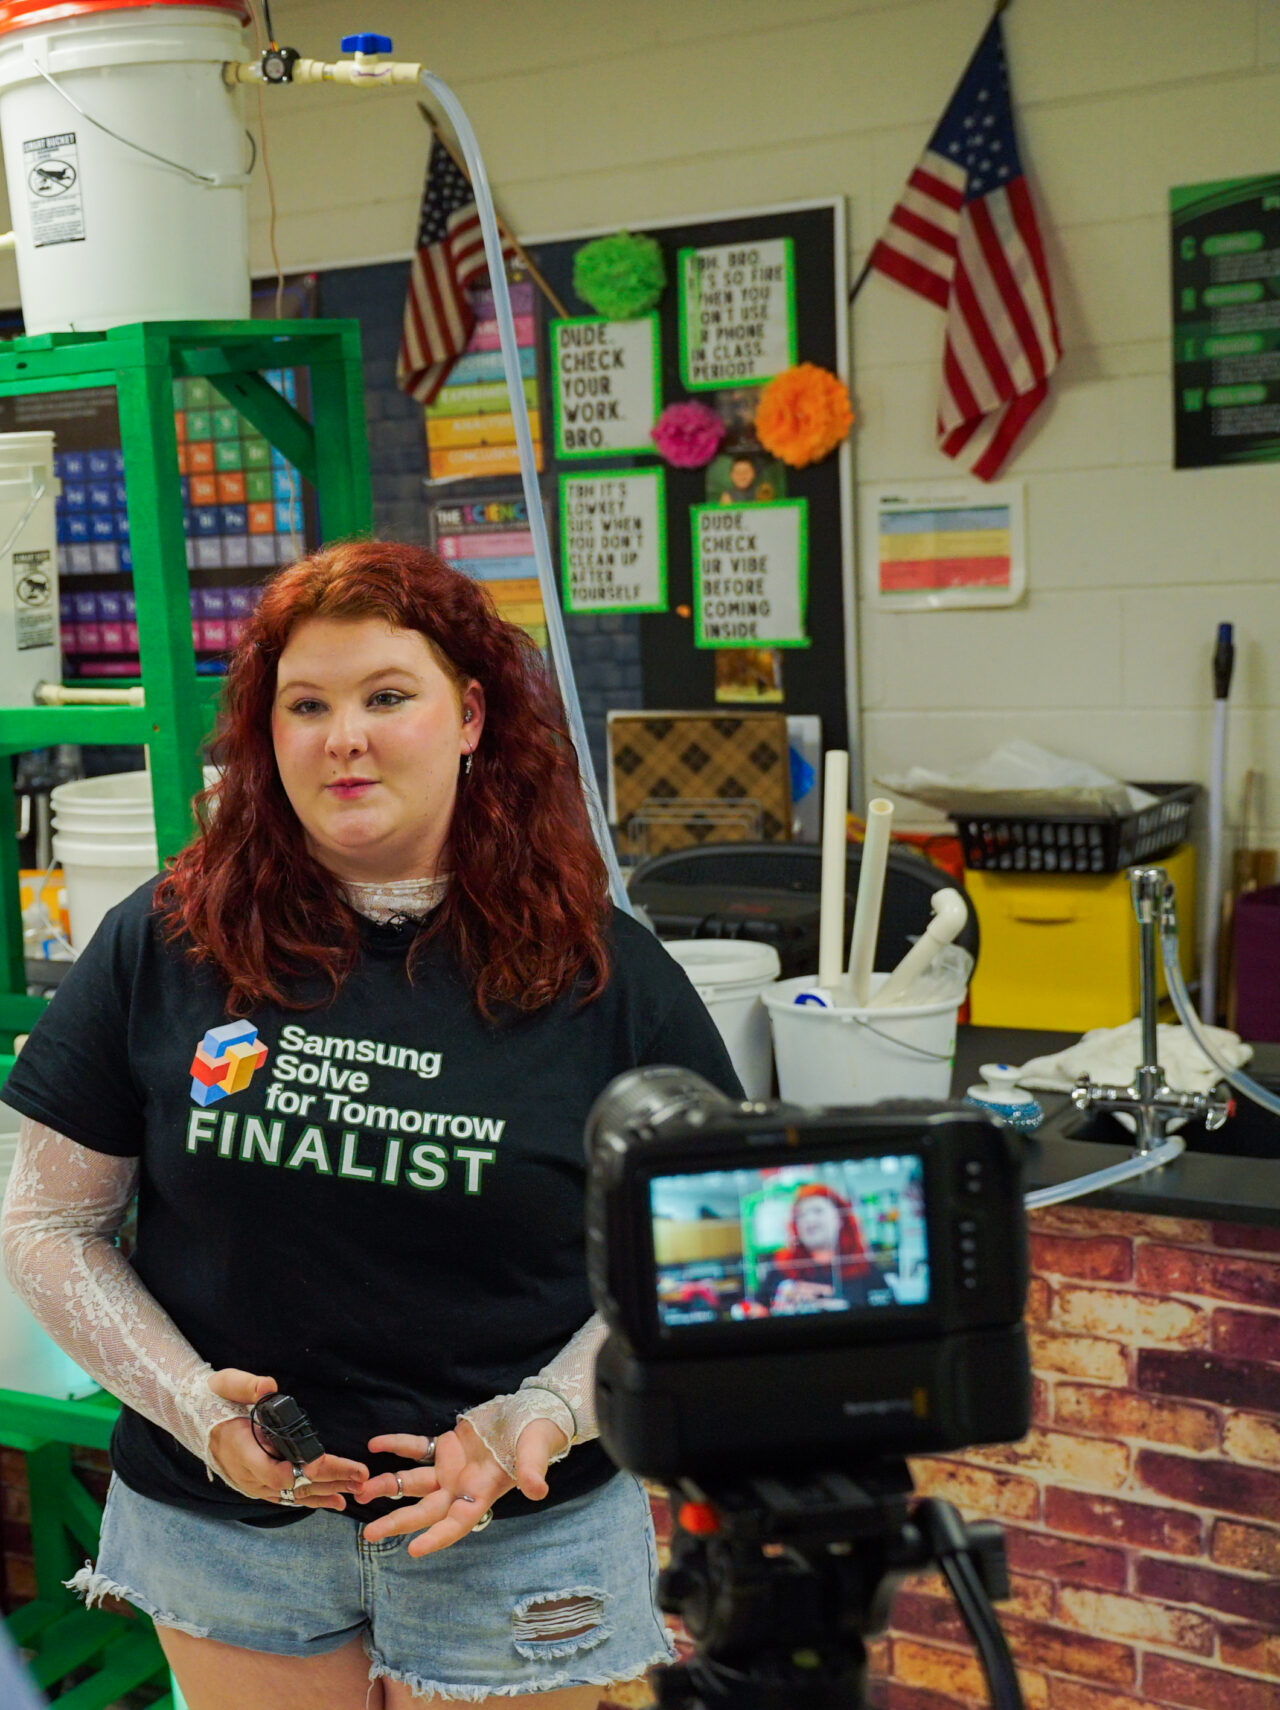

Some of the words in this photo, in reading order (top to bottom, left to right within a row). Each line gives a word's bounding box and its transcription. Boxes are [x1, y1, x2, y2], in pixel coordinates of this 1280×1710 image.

[723, 271, 744, 286] SO
[751, 264, 783, 282] FIRE
[741, 286, 771, 302] YOU
[741, 303, 768, 321] USE
[716, 323, 765, 343] PHONE
[561, 347, 624, 373] CHECK
[562, 375, 611, 398] YOUR
[437, 508, 461, 525] THE
[464, 501, 528, 524] SCIENC
[568, 500, 624, 516] LOWKEY
[570, 519, 593, 533] SUS
[602, 517, 642, 531] WHEN
[570, 537, 595, 550] YOU
[701, 535, 756, 553] CHECK
[570, 553, 614, 567] CLEAN
[622, 552, 638, 566] UP
[702, 558, 723, 576] UR
[730, 555, 768, 574] VIBE
[572, 570, 613, 583] AFTER
[572, 585, 640, 600] YOURSELF
[703, 577, 765, 597] BEFORE
[704, 600, 771, 618] COMING
[705, 621, 759, 639] INSIDE
[279, 1025, 442, 1078] Samsung
[272, 1054, 369, 1093] Solve
[265, 1083, 316, 1116] for
[324, 1093, 506, 1143] Tomorrow
[186, 1107, 496, 1195] FINALIST
